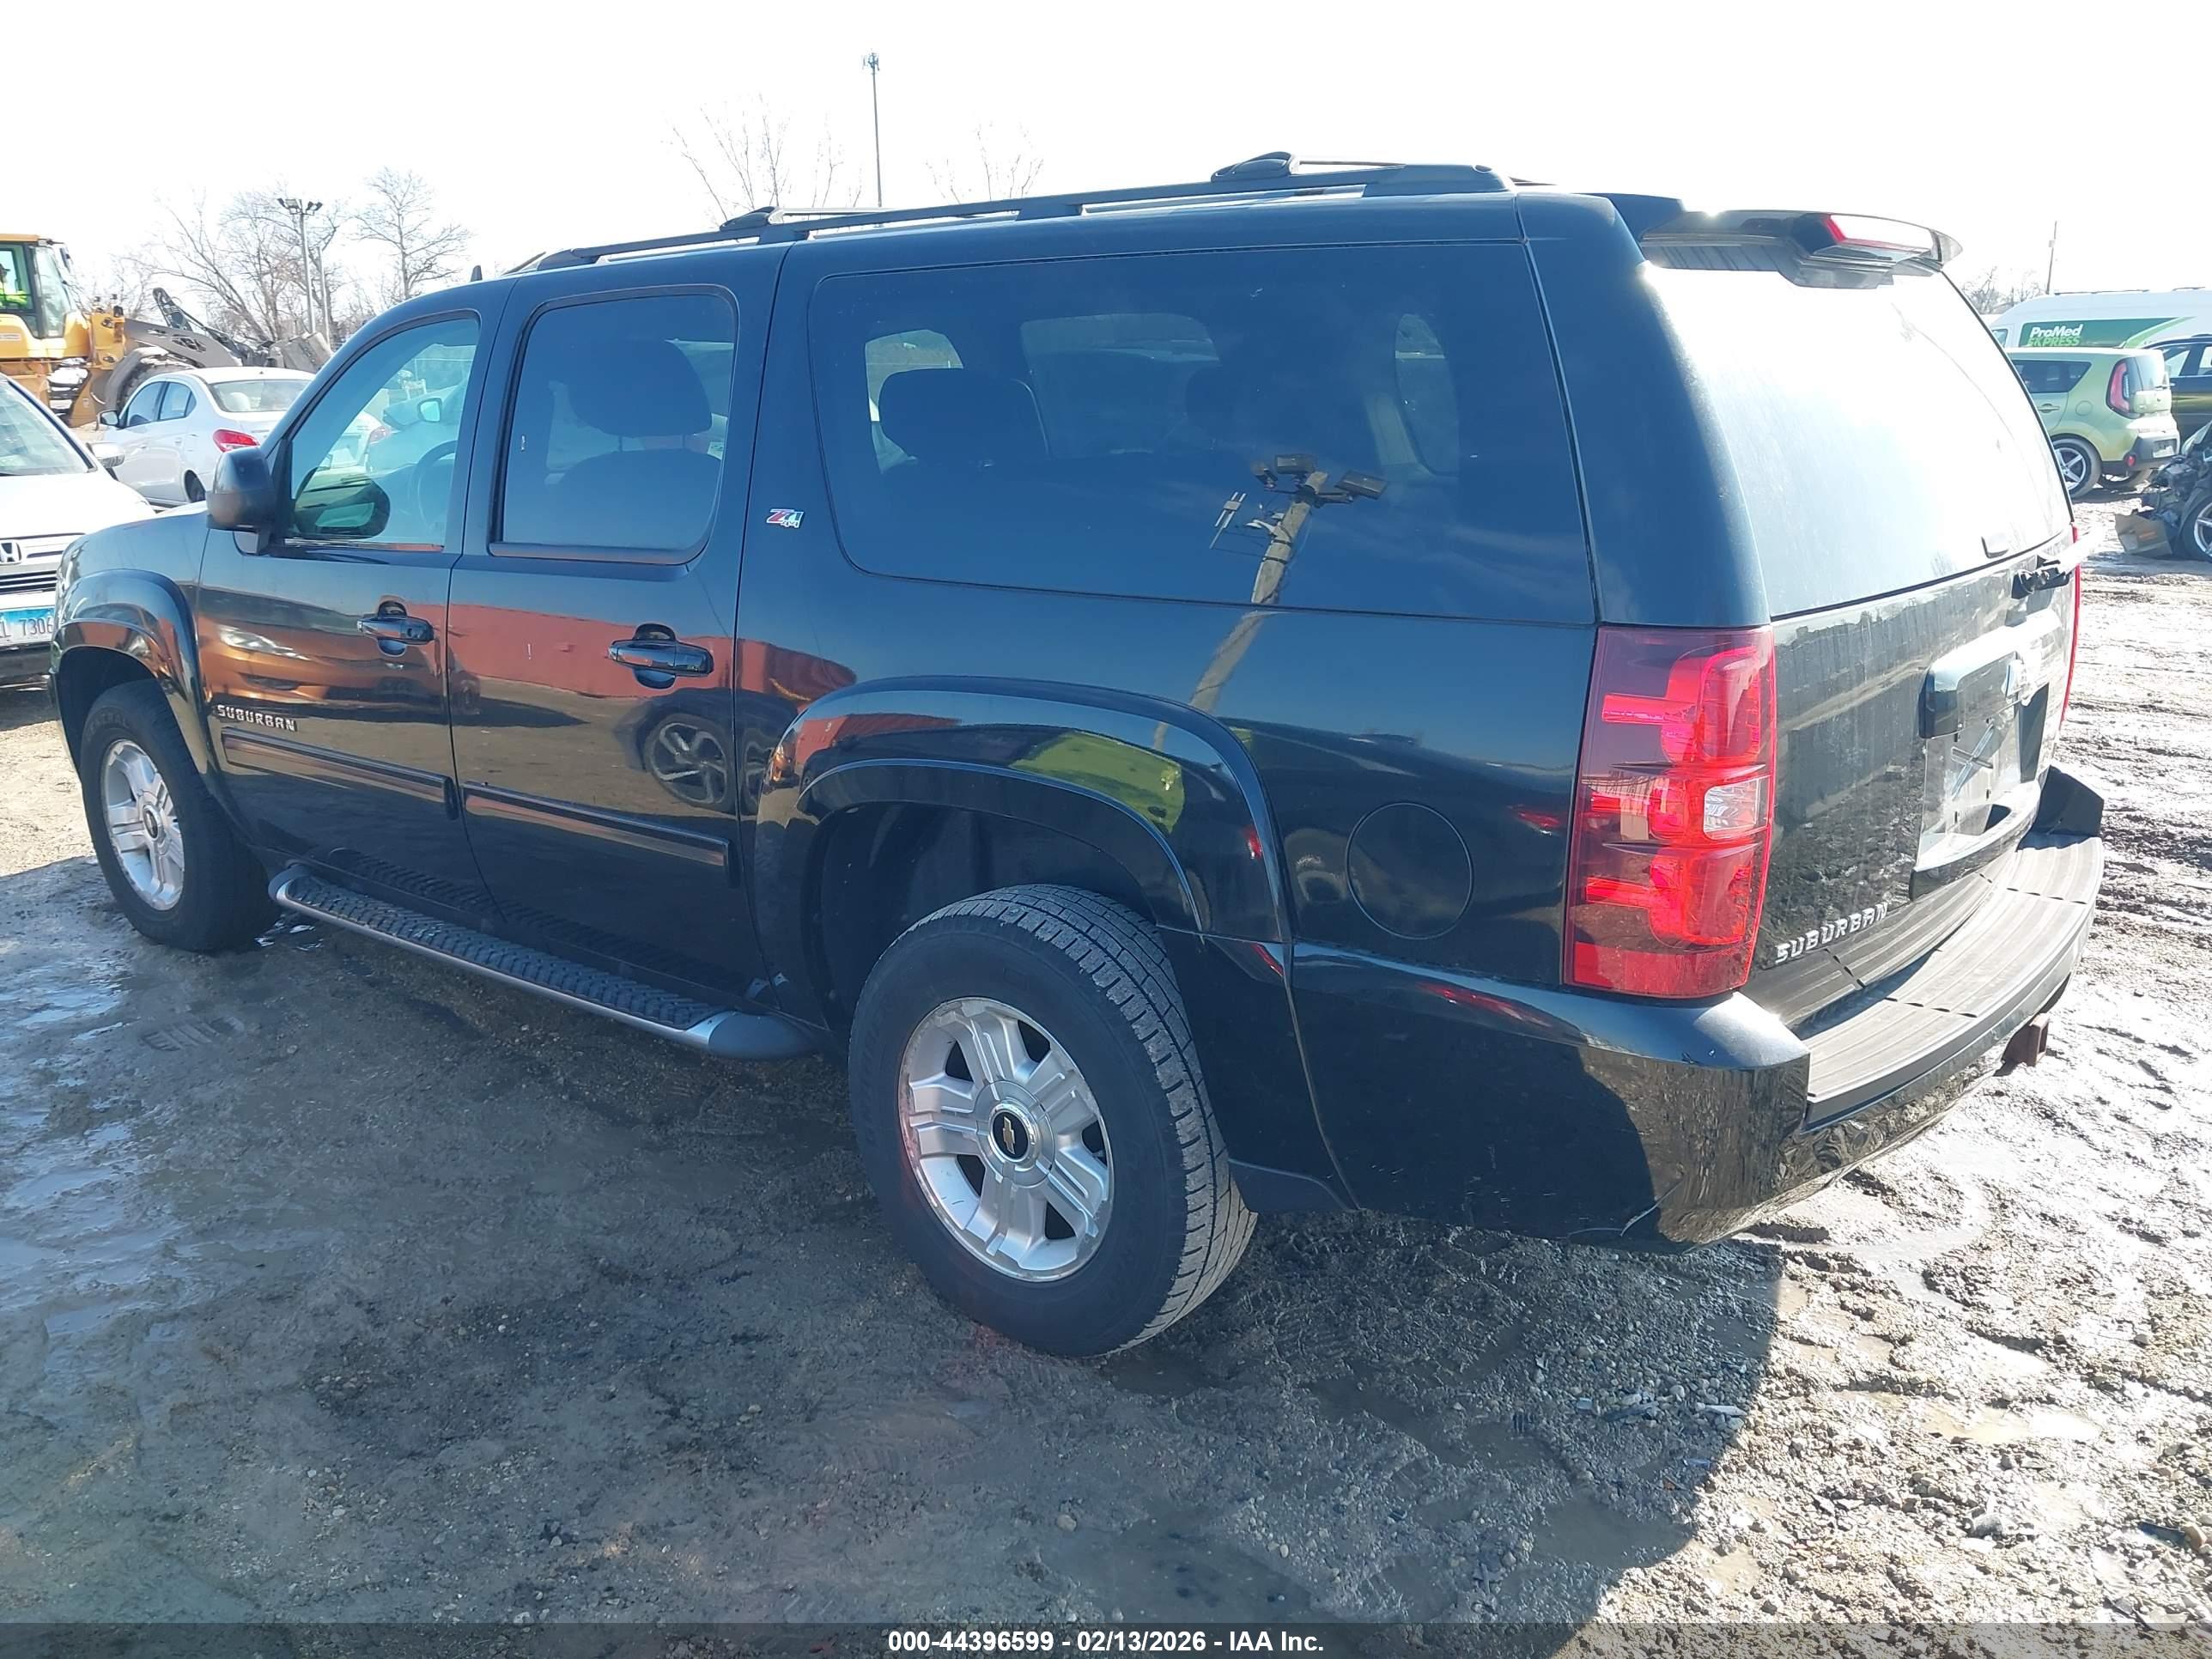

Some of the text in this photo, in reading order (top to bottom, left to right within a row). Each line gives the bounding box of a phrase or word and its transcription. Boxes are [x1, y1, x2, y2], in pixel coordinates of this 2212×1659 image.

[2029, 323, 2083, 337] ProMed
[2027, 336, 2081, 347] EXPRESS
[217, 704, 296, 732] SUBURBAN
[1774, 901, 1888, 964] SUBURBAN
